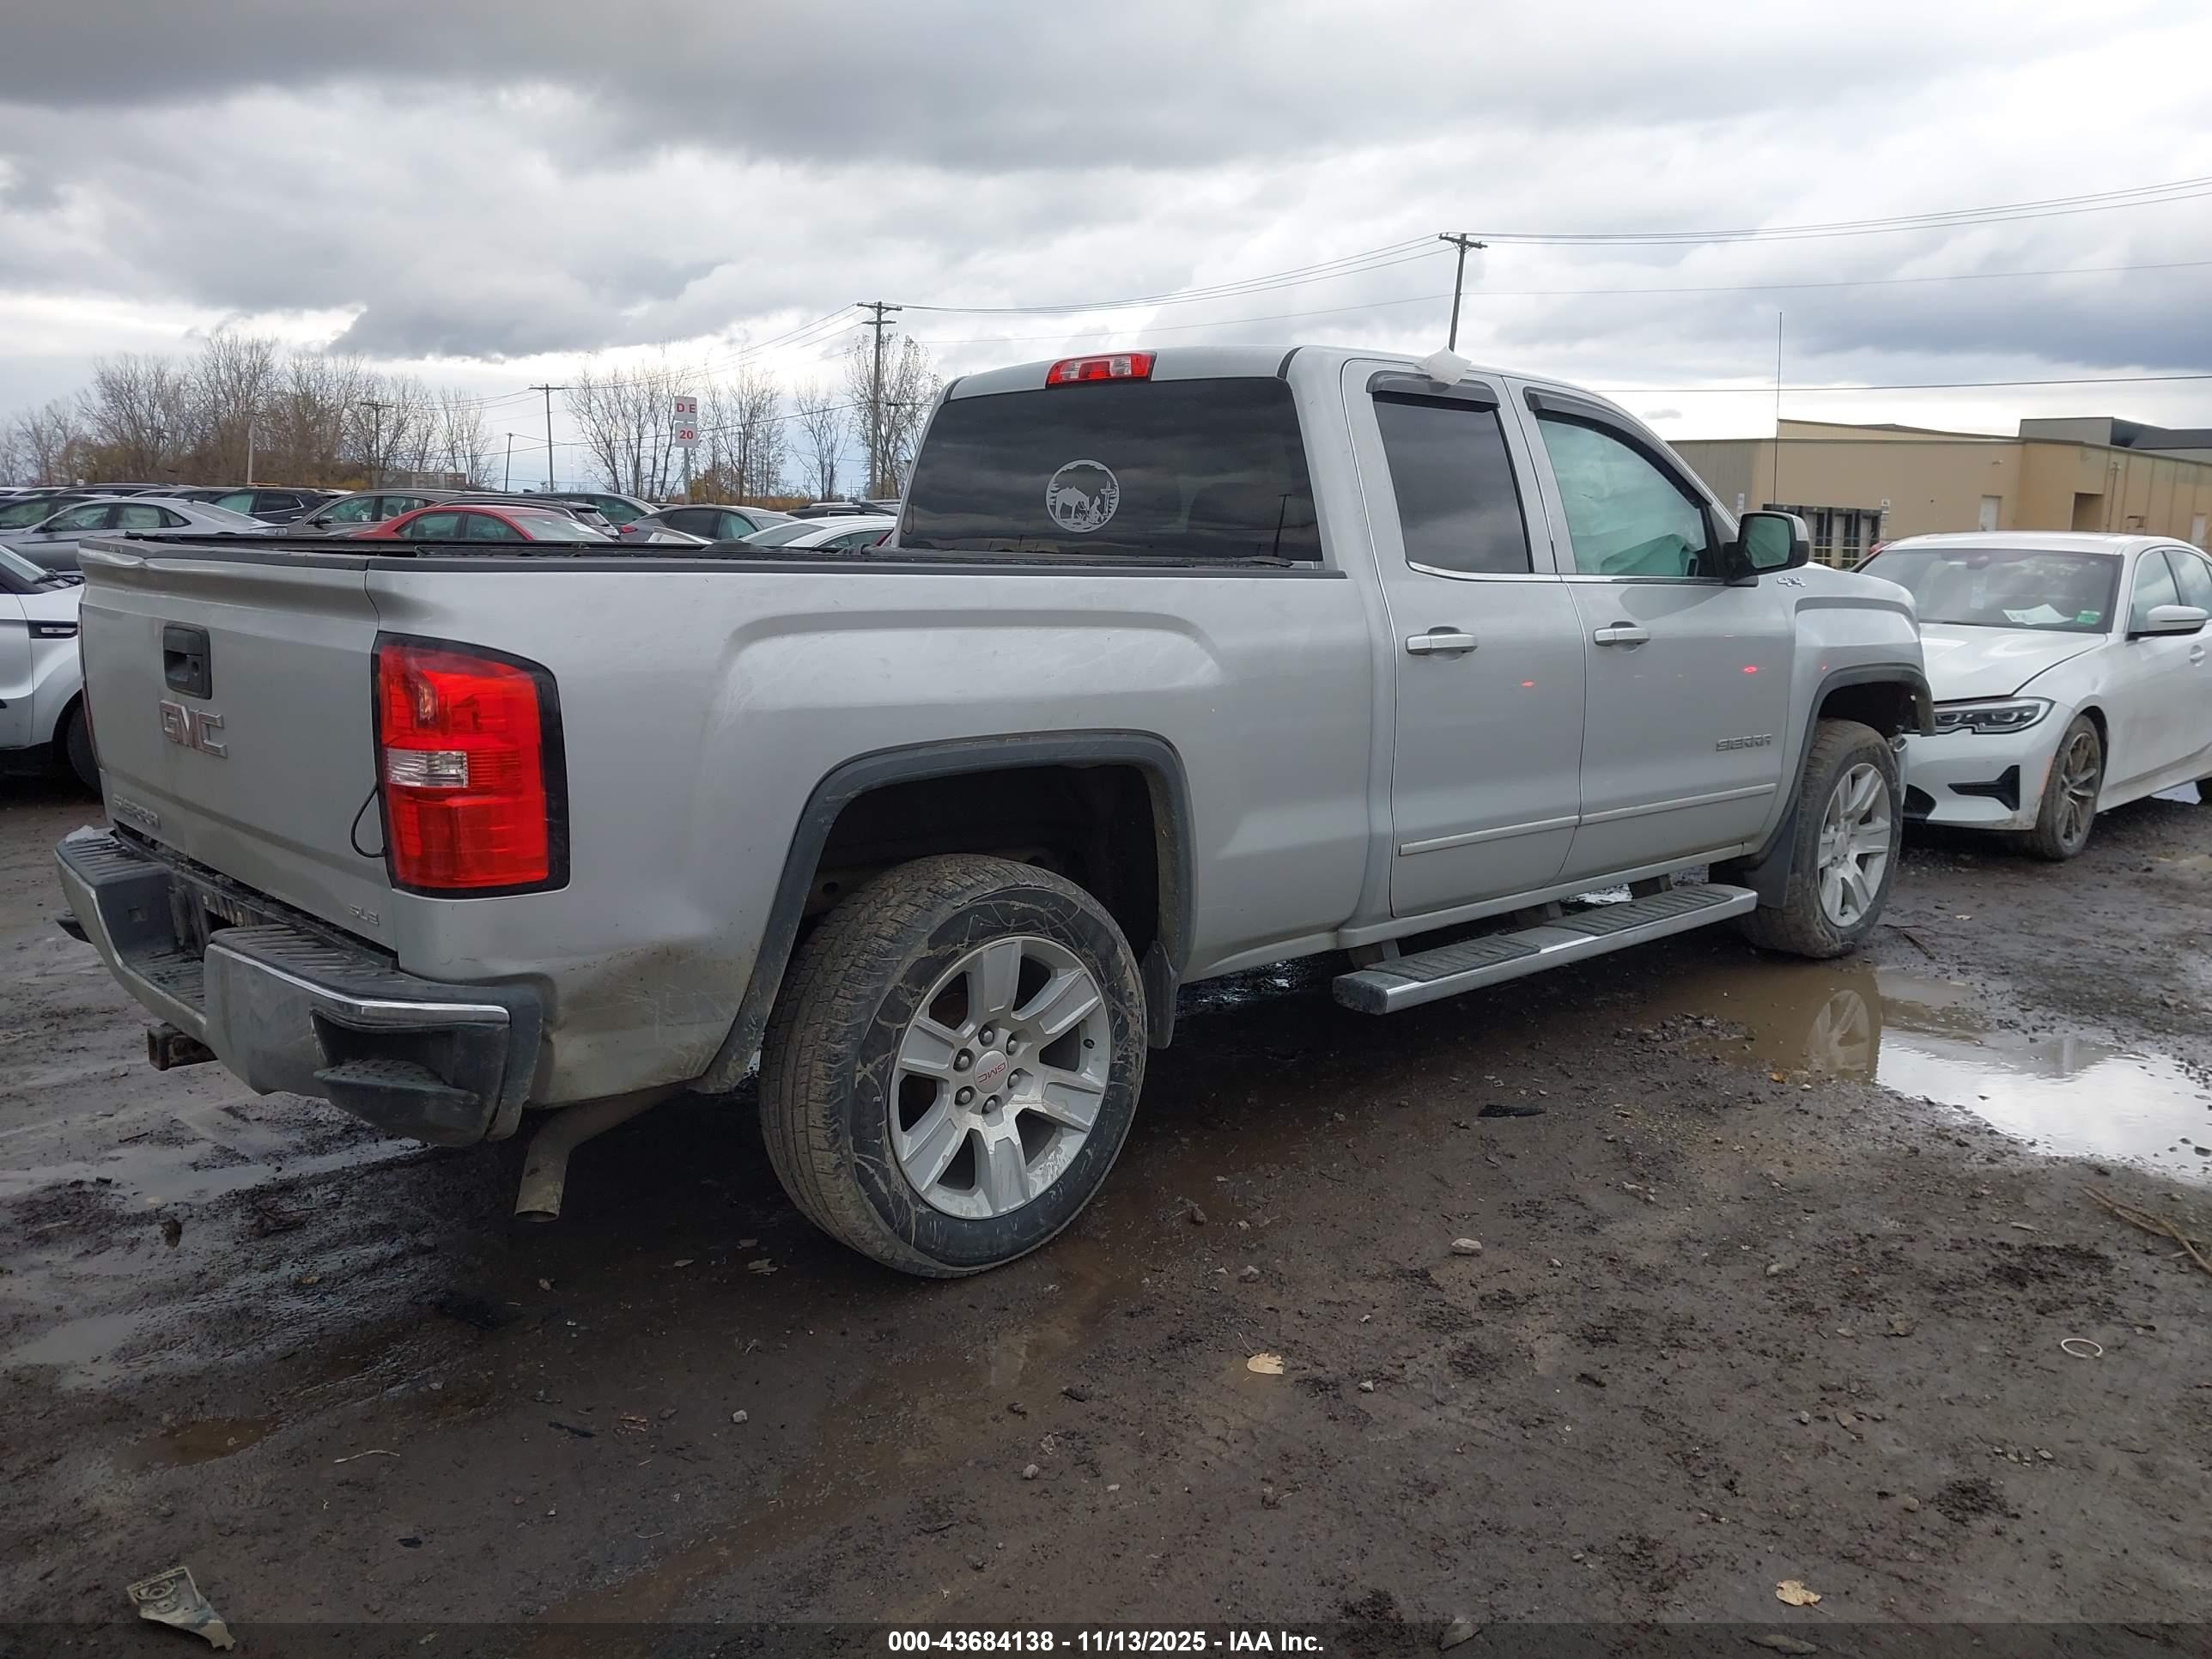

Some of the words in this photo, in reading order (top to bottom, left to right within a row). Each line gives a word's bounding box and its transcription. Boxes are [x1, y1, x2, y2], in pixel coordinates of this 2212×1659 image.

[677, 404, 684, 412] D
[690, 404, 696, 413] E
[679, 430, 694, 440] 20
[159, 700, 228, 759] GMC
[1717, 733, 1772, 751] SIERRA
[349, 903, 380, 927] SLE
[977, 1061, 1006, 1084] GMC
